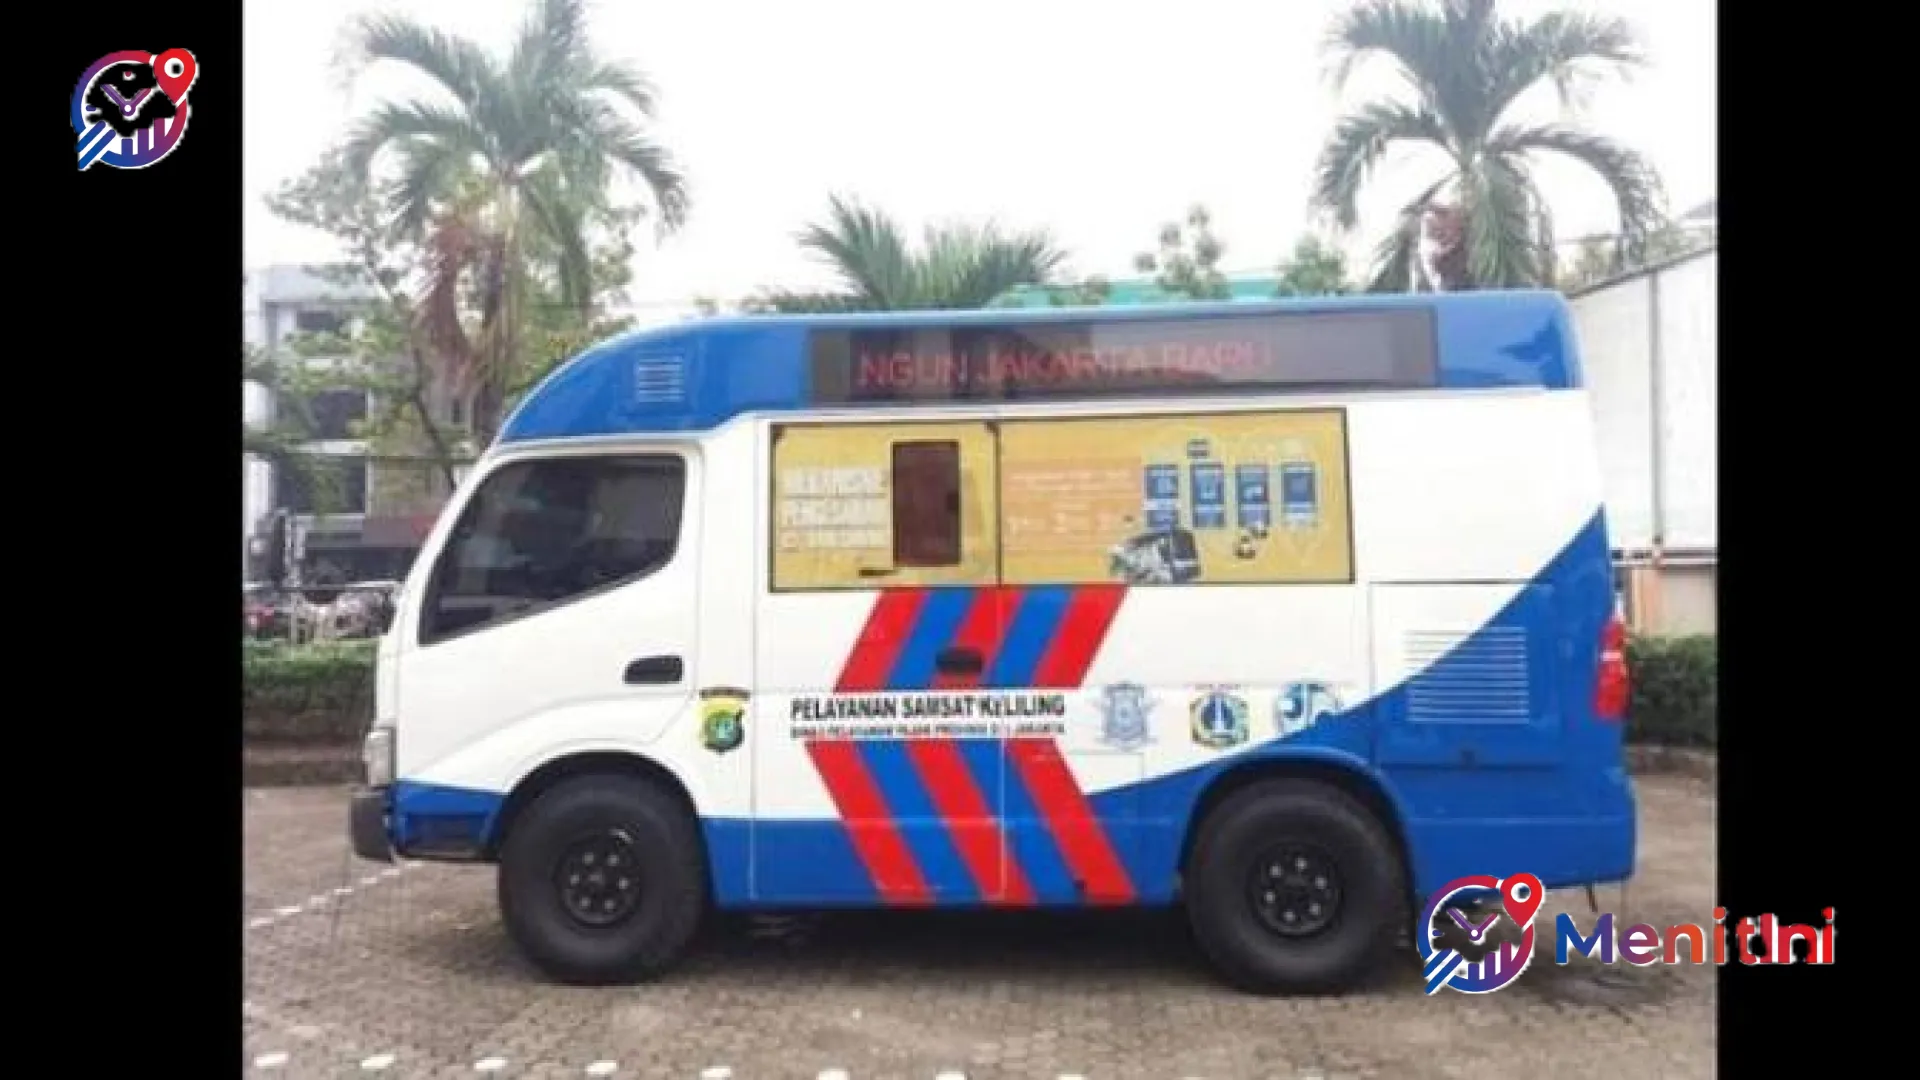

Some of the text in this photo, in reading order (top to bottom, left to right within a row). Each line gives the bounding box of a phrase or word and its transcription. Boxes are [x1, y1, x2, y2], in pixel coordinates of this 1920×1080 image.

[791, 695, 1066, 719] PELAYANAN SAMSAT KELILING
